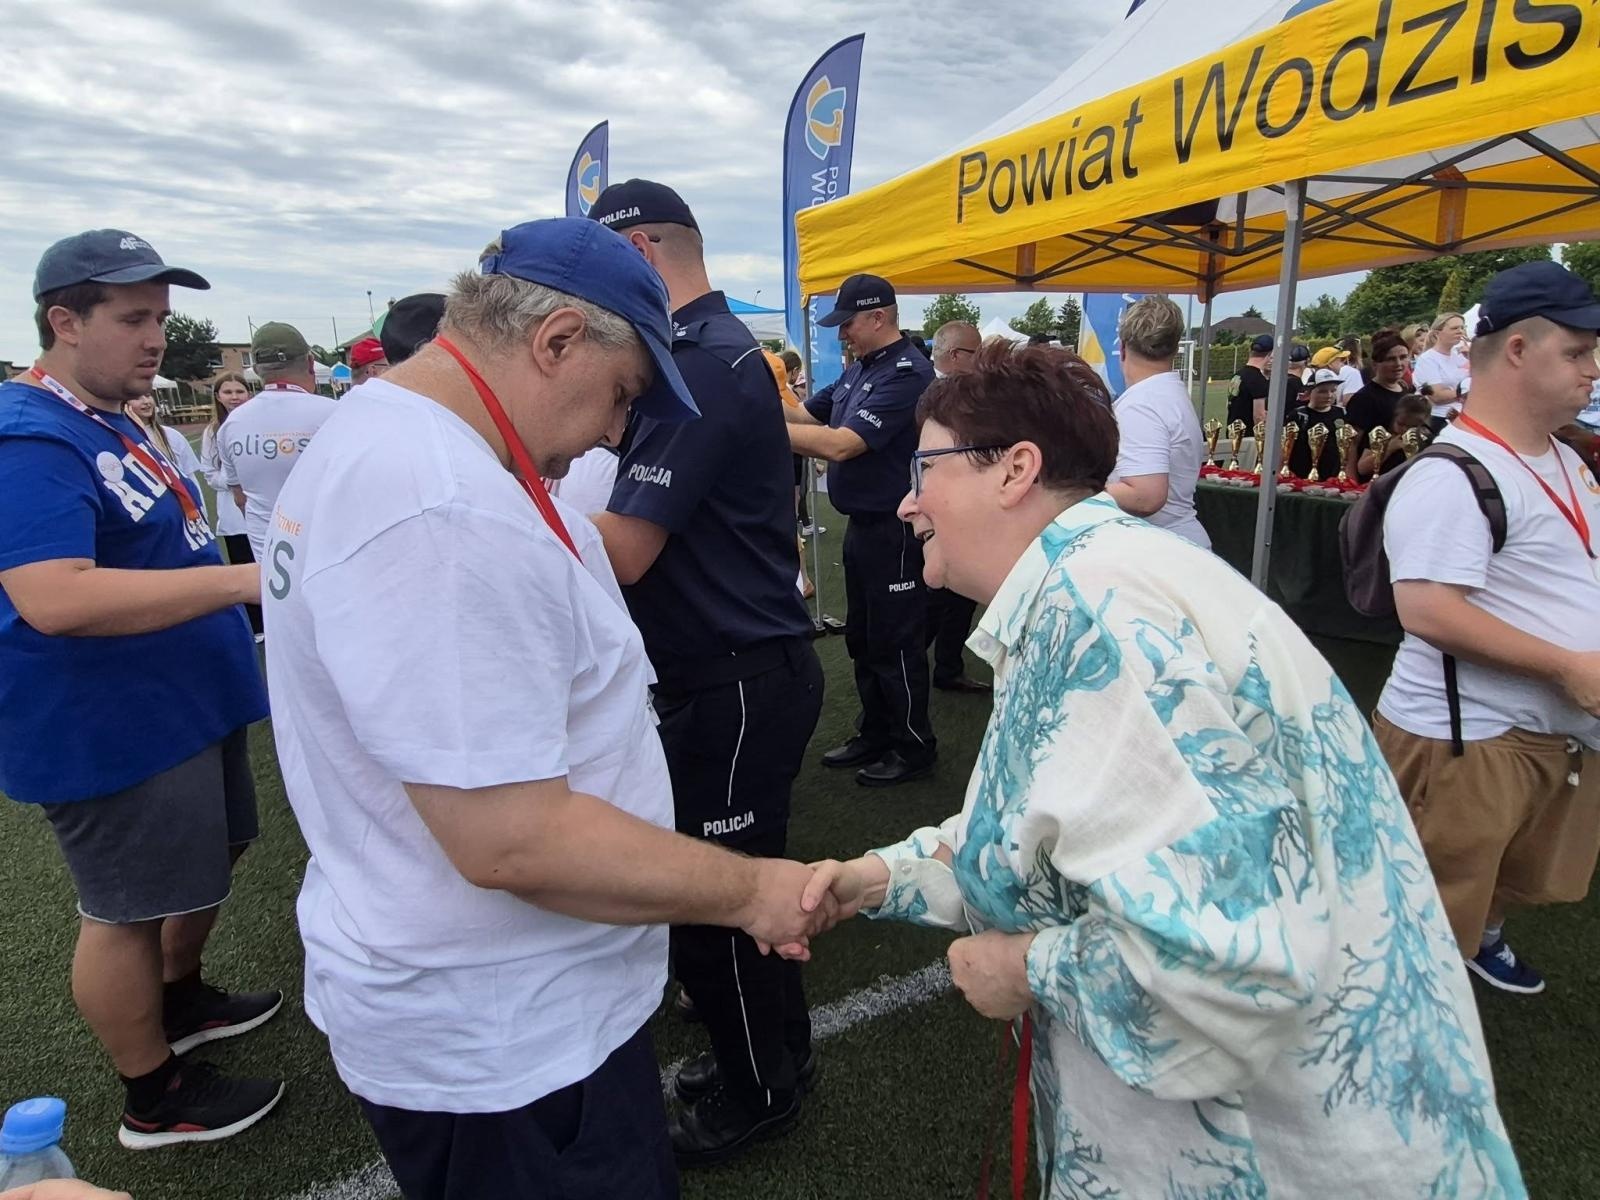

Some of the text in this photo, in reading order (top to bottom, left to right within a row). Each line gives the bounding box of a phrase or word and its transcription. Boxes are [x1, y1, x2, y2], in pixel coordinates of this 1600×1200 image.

[957, 0, 1600, 224] Powiat Wodzis
[599, 206, 641, 225] POLICJA
[856, 297, 881, 307] POLICJA
[856, 408, 883, 429] POLICJA
[628, 463, 672, 488] POLCJA
[888, 580, 916, 593] POLICJA
[703, 810, 755, 837] POLICJA
